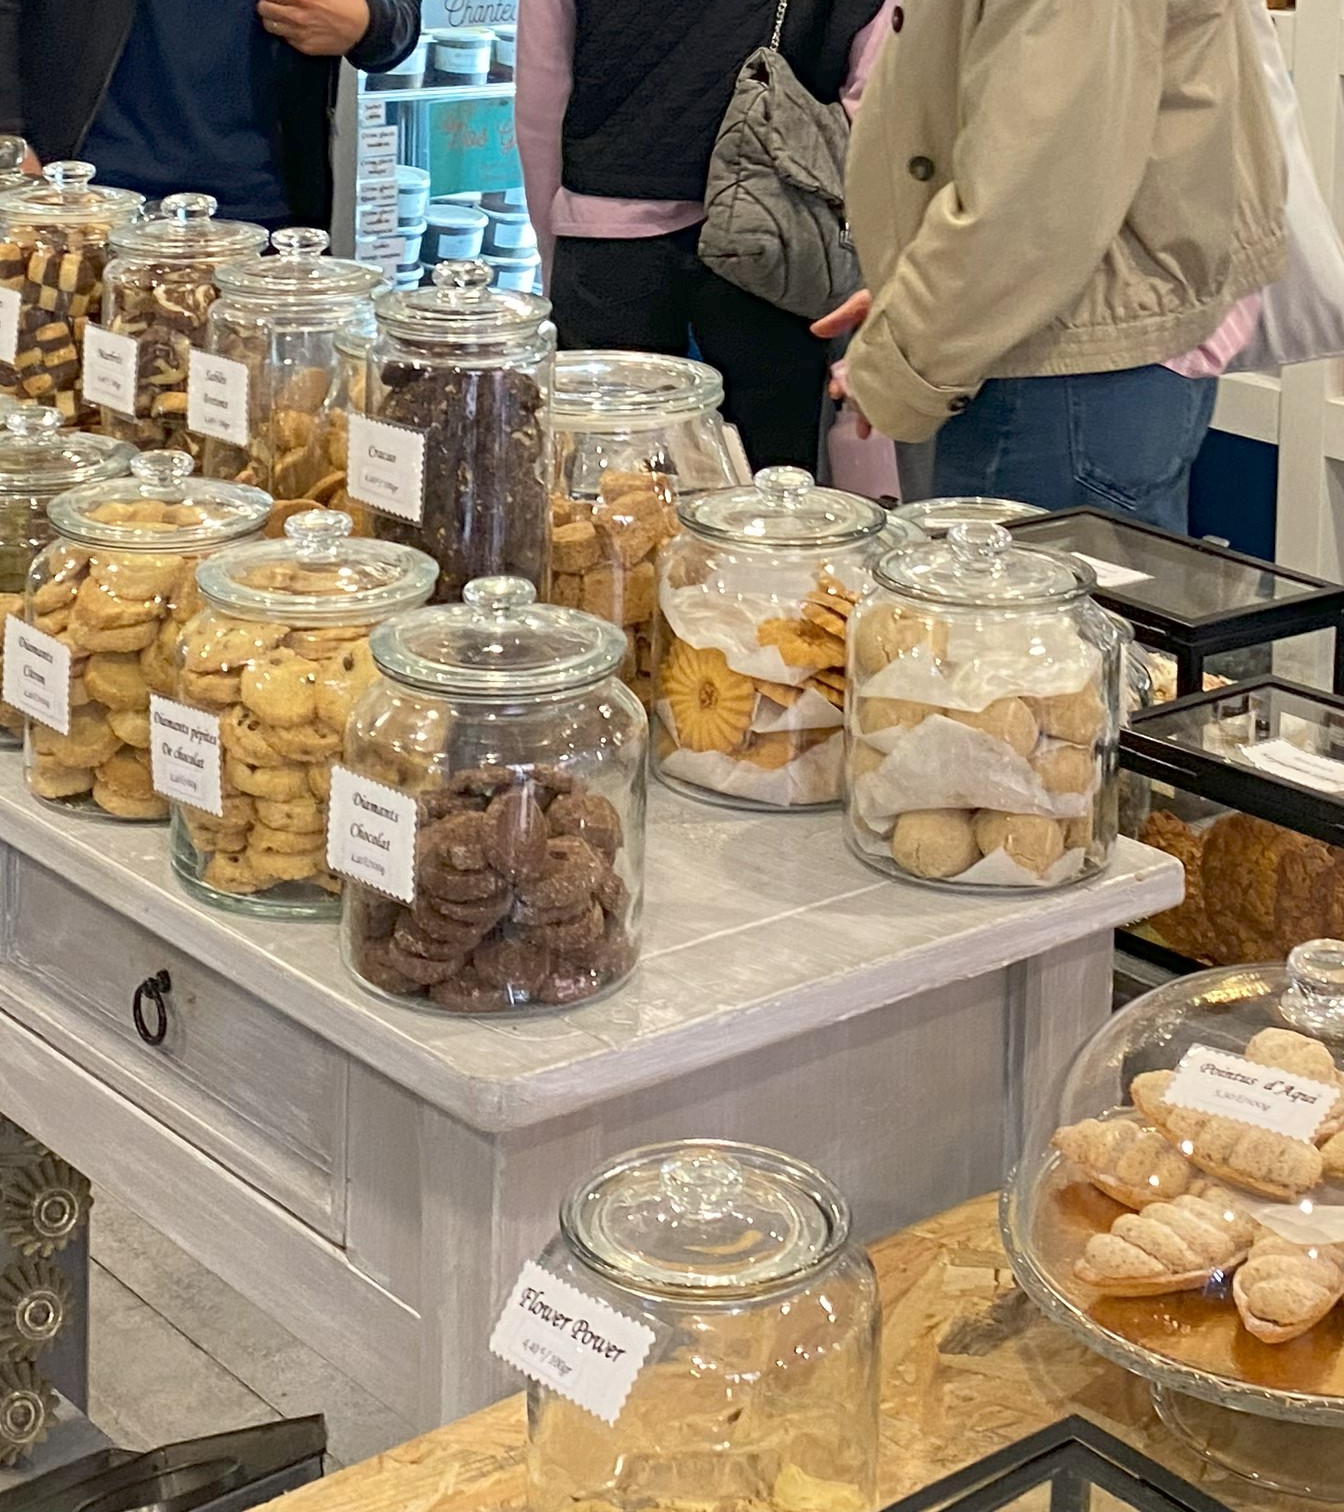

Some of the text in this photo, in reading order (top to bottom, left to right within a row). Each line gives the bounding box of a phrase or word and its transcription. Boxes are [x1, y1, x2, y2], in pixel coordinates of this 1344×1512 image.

[174, 746, 205, 768] chocolat
[352, 792, 400, 823] Diamants
[350, 823, 391, 851] Chocolat
[1200, 1062, 1259, 1086] Pointus
[519, 1287, 627, 1362] Flower Power
